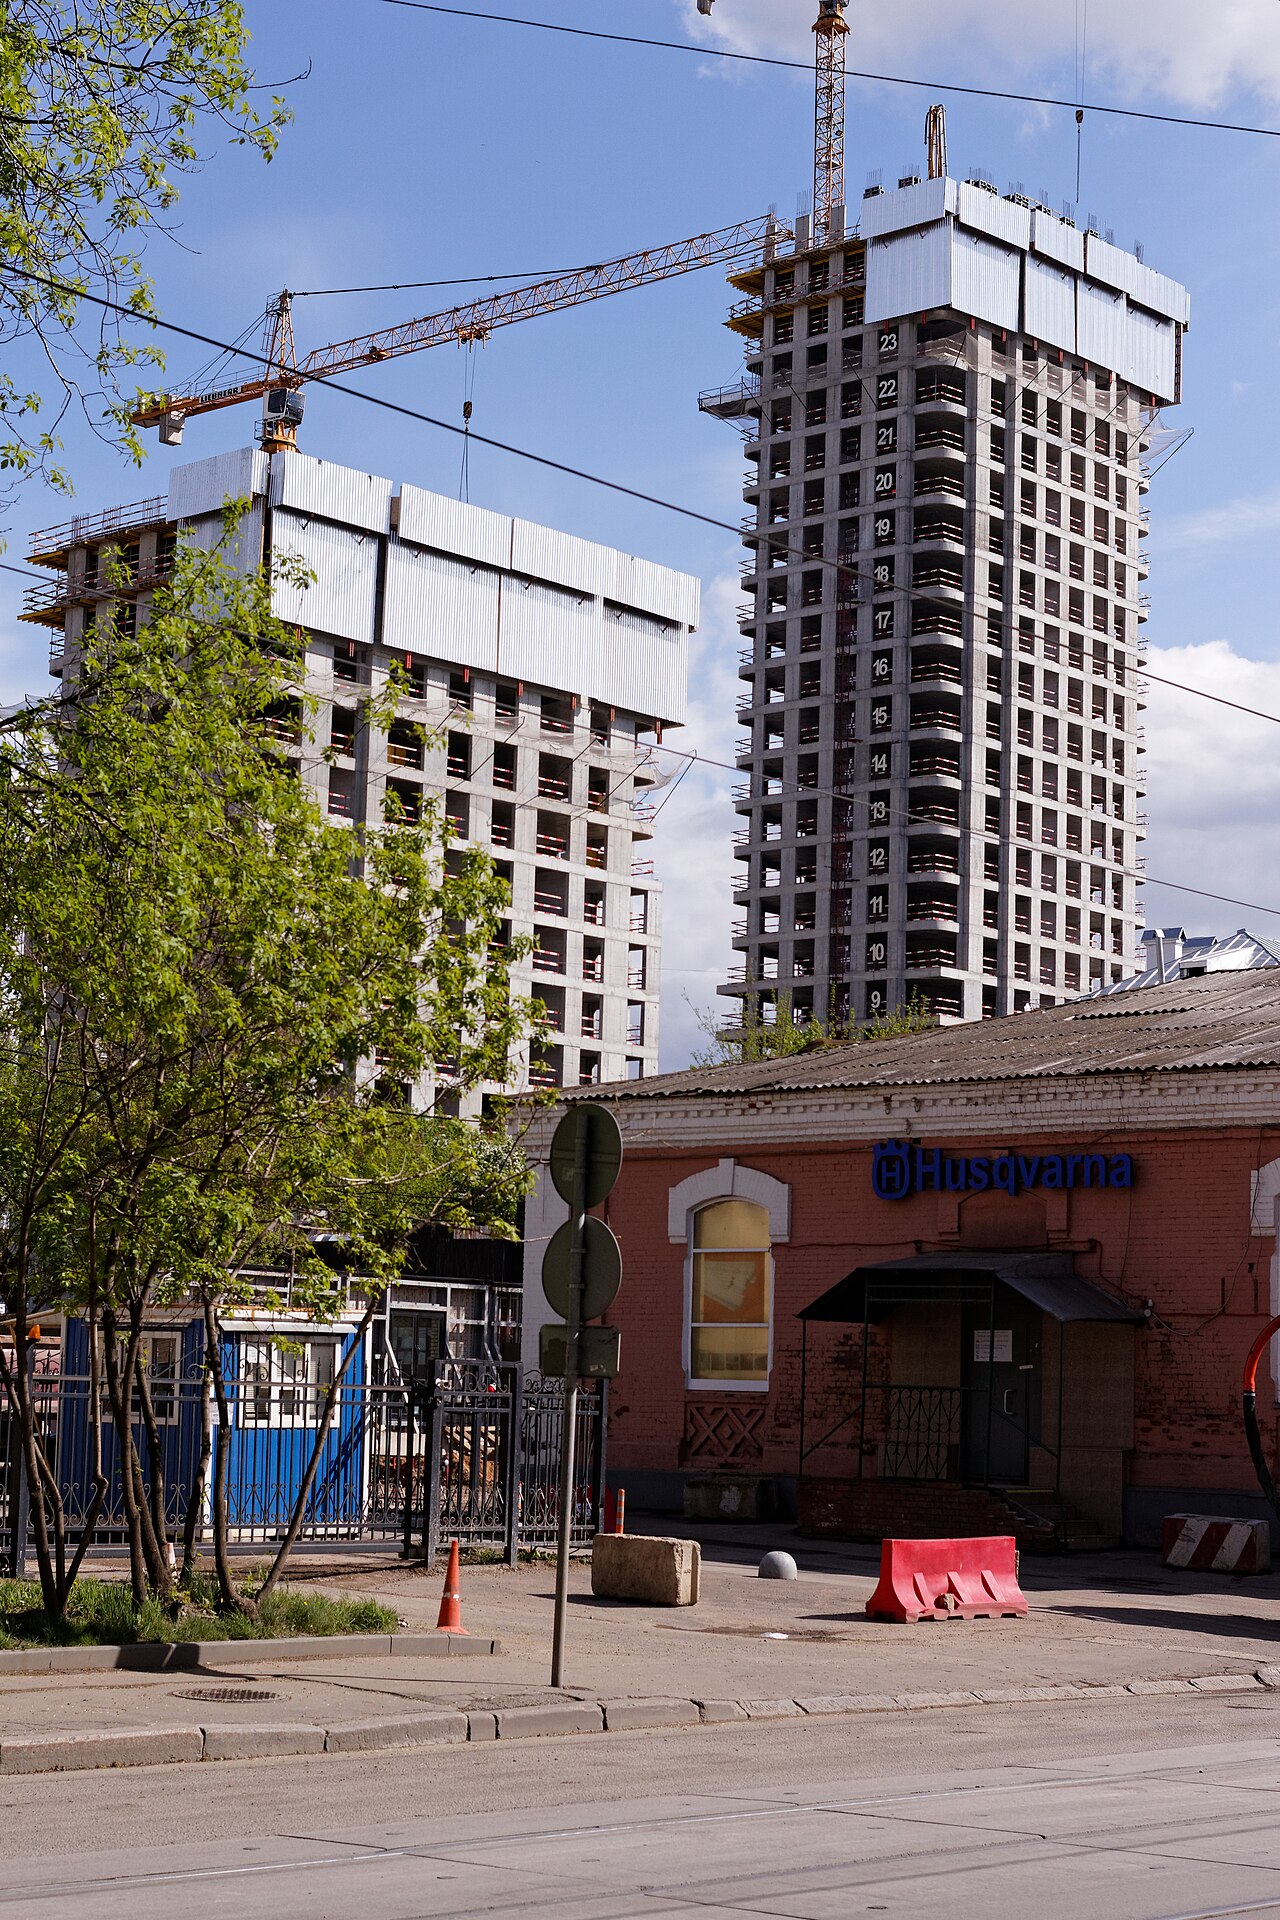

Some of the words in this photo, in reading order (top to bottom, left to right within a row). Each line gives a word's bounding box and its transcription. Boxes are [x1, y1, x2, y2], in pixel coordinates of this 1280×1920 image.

[880, 333, 898, 352] 23
[879, 379, 896, 398] 22
[877, 427, 893, 446] 21
[875, 473, 892, 491] 20
[875, 519, 890, 537] 19
[874, 565, 889, 582] 18
[875, 611, 891, 629] 17
[873, 658, 888, 676] 16
[872, 706, 887, 724] 15
[871, 754, 887, 772] 14
[871, 801, 885, 819] 13
[870, 848, 885, 866] 12
[870, 895, 882, 914] 11
[870, 943, 884, 961] 10
[871, 991, 881, 1009] 9
[915, 1147, 1134, 1197] Husqvarna
